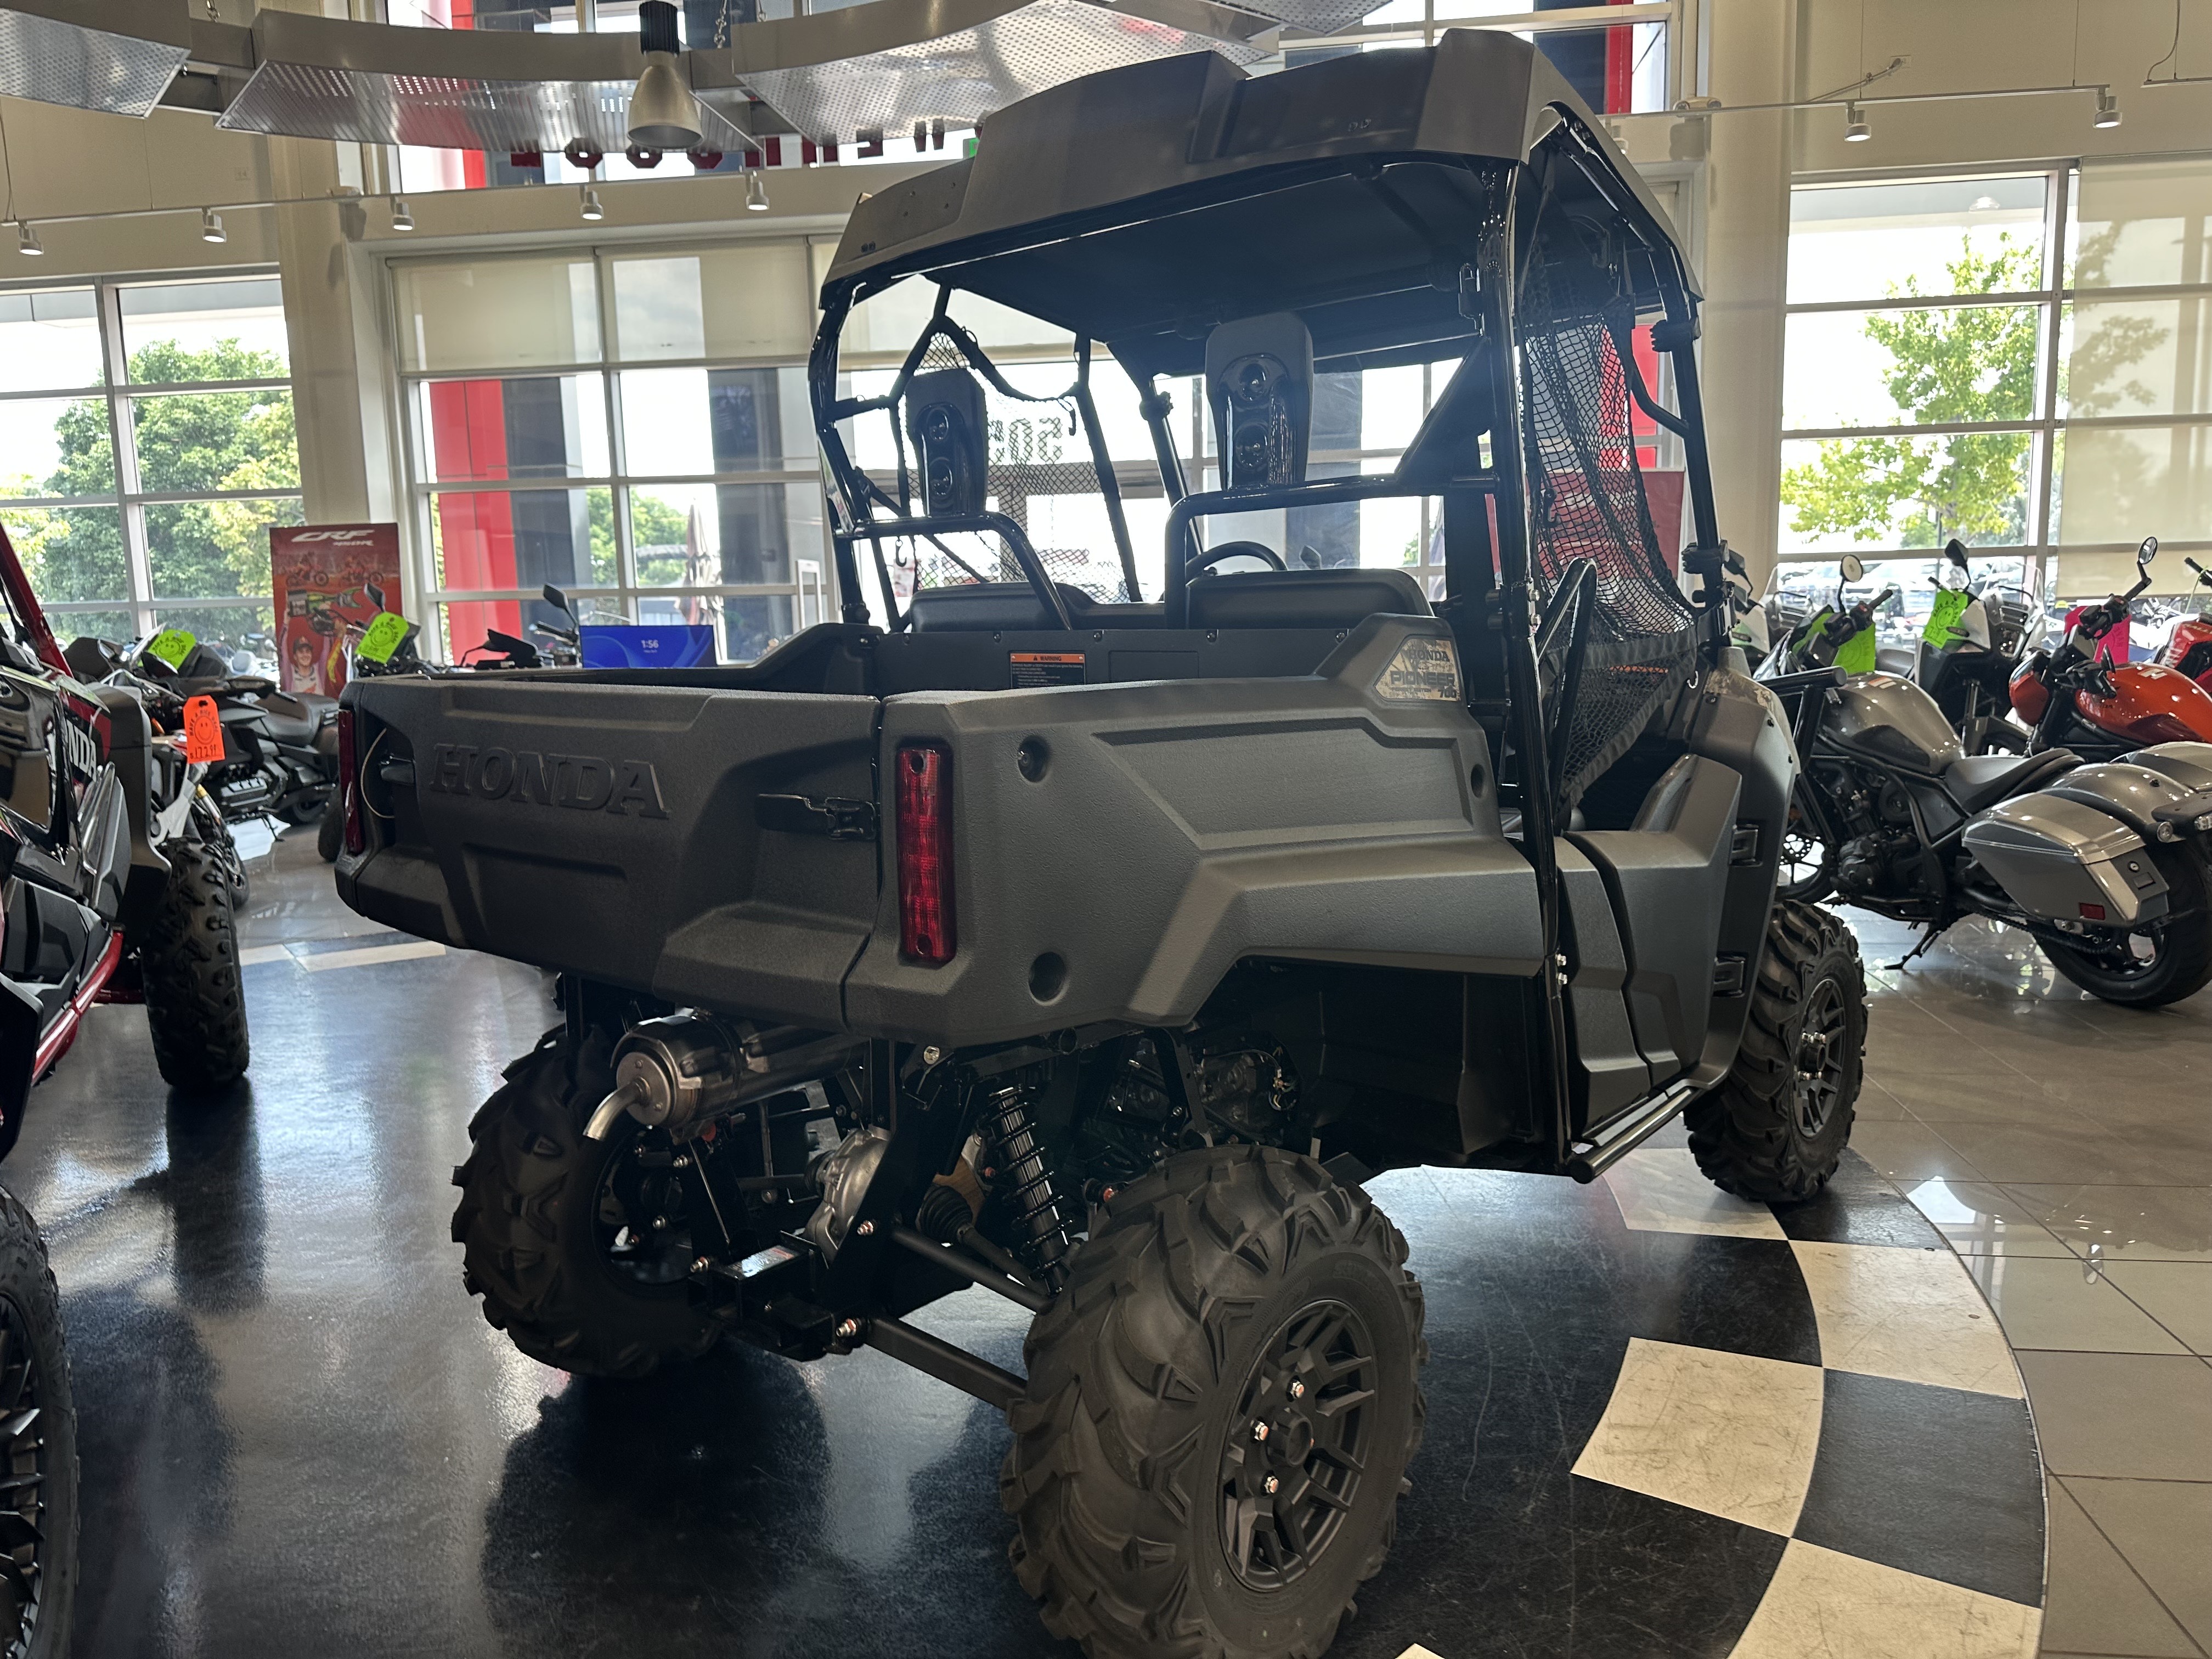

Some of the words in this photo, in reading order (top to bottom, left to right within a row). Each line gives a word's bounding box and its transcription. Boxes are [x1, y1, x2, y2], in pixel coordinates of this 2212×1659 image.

[291, 529, 375, 542] CRF
[641, 639, 659, 649] 1:56
[1408, 649, 1450, 662] HONDA
[1390, 670, 1455, 687] PIONEER
[1437, 686, 1457, 698] 700
[429, 742, 672, 820] HONDA
